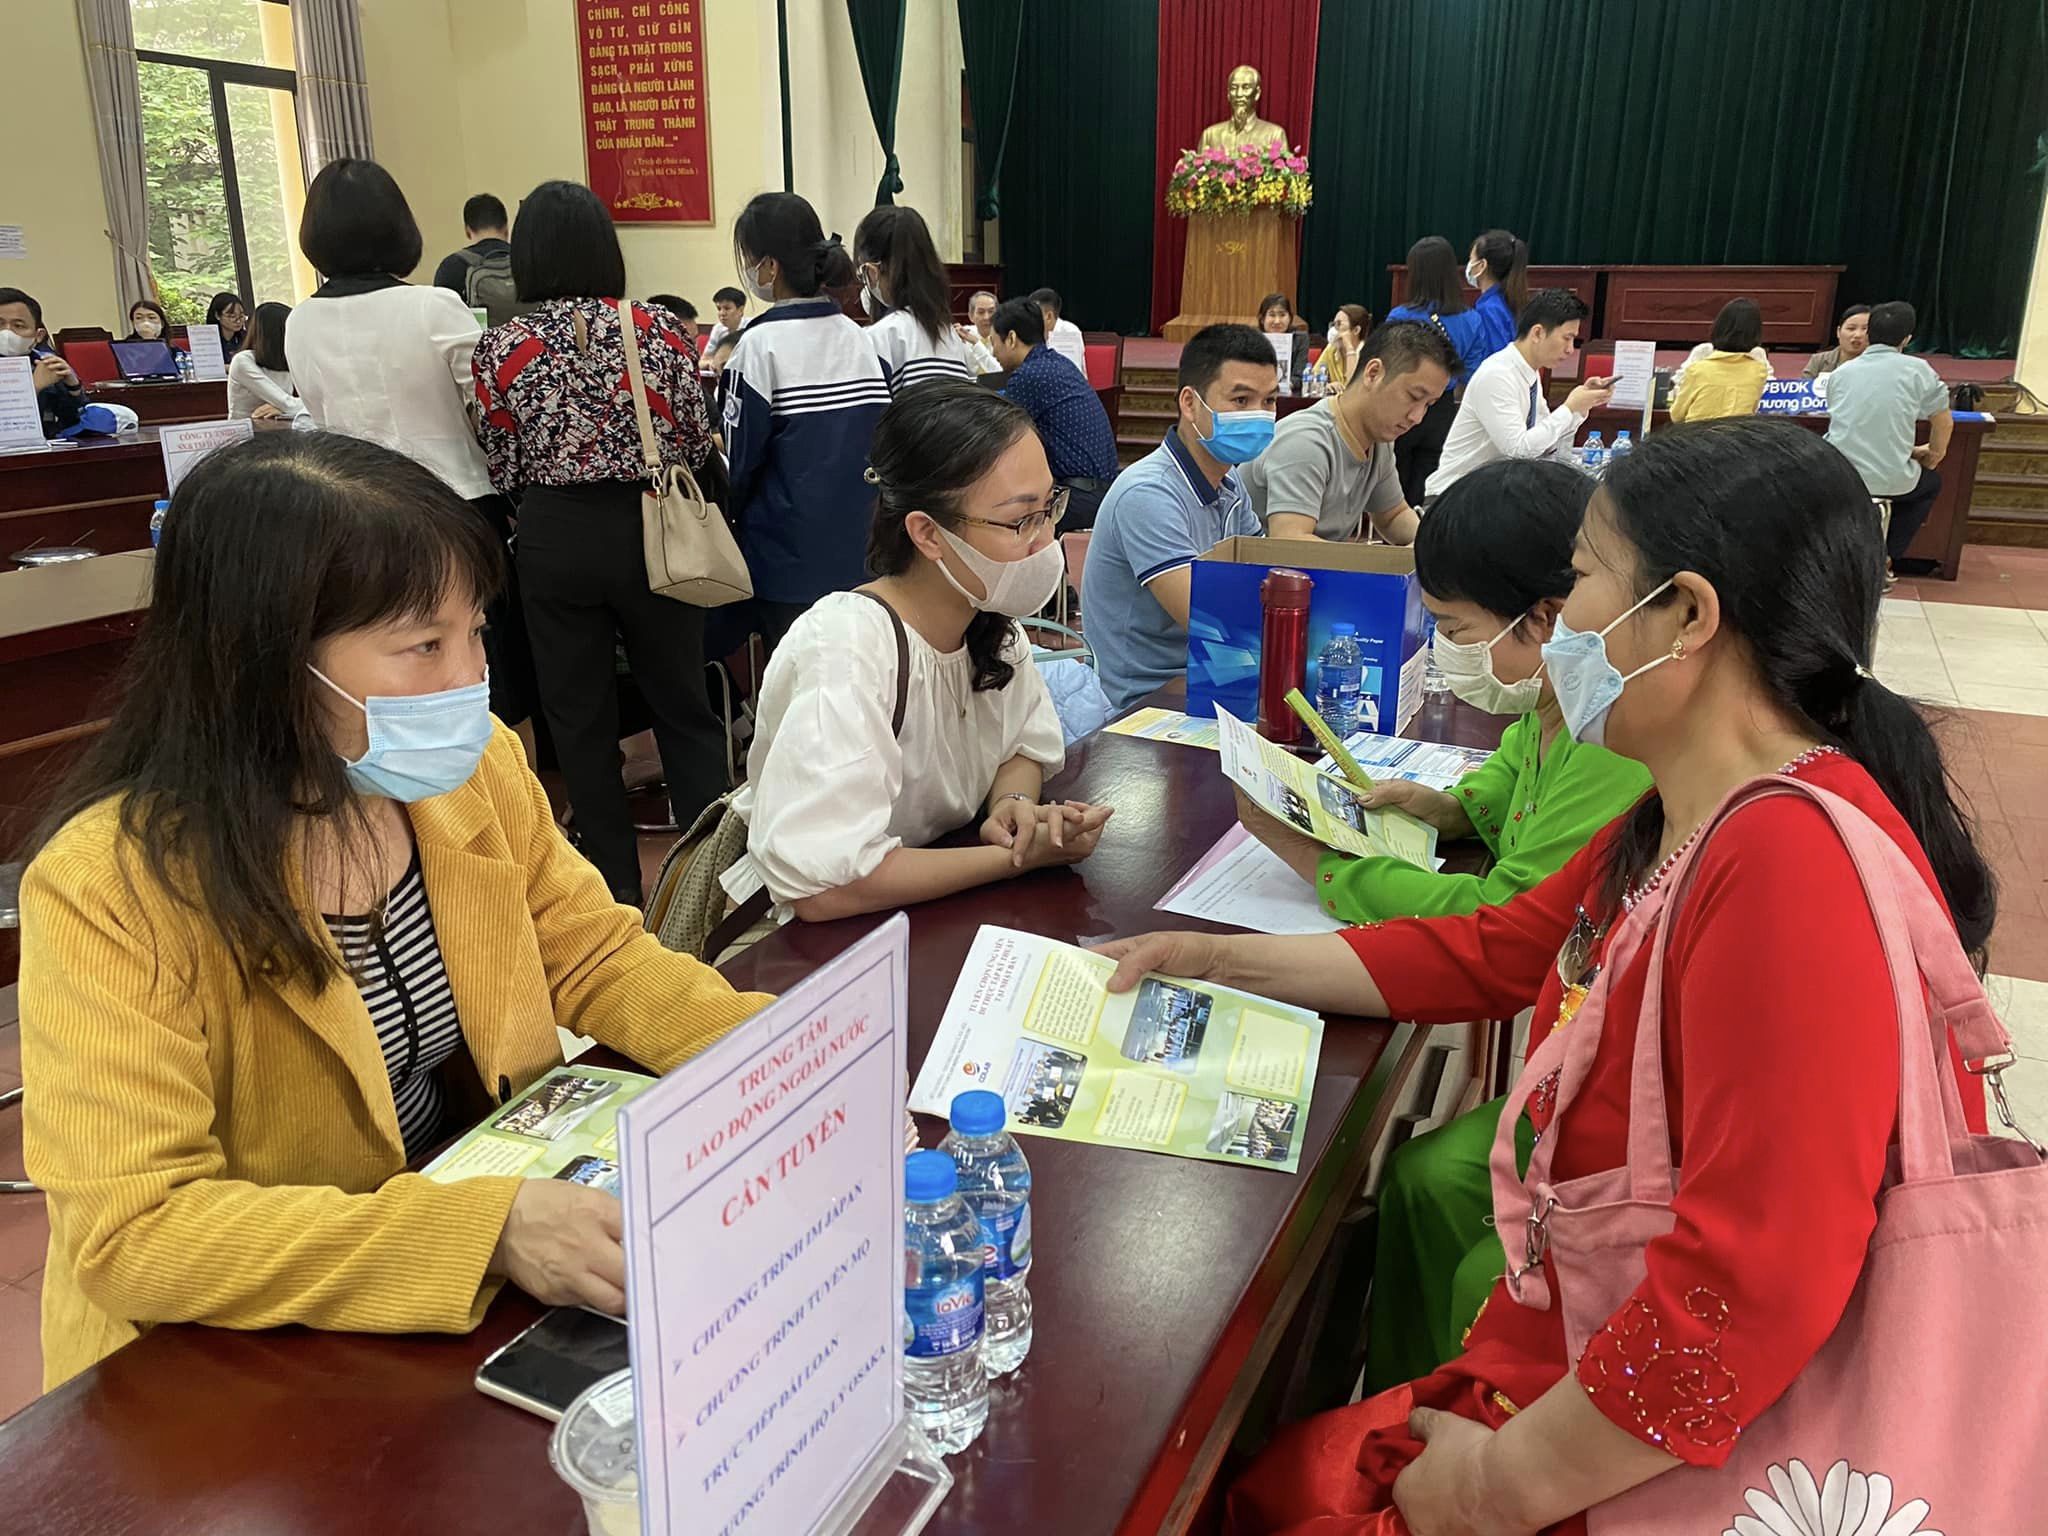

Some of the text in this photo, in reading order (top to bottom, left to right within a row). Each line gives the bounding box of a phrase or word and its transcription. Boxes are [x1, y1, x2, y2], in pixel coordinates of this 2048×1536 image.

[659, 1, 690, 16] CÔNG
[588, 25, 603, 40] VÔ
[617, 45, 630, 57] TA
[658, 41, 693, 54] TRONG
[629, 58, 655, 75] PHẢI
[624, 118, 655, 131] TRUNG
[663, 115, 696, 129] THÀNH
[595, 134, 614, 150] CỦA
[616, 135, 642, 149] NHÂN
[738, 1015, 829, 1097] TRUNG TÂM
[685, 1013, 869, 1171] LAO ĐỘNG NGOÀI NƯỚC
[722, 1167, 771, 1227] CẦN
[806, 1218, 822, 1246] IM
[825, 1180, 863, 1227] JAPAN
[804, 1333, 840, 1379] LOAN
[848, 1344, 887, 1393] OSAKA
